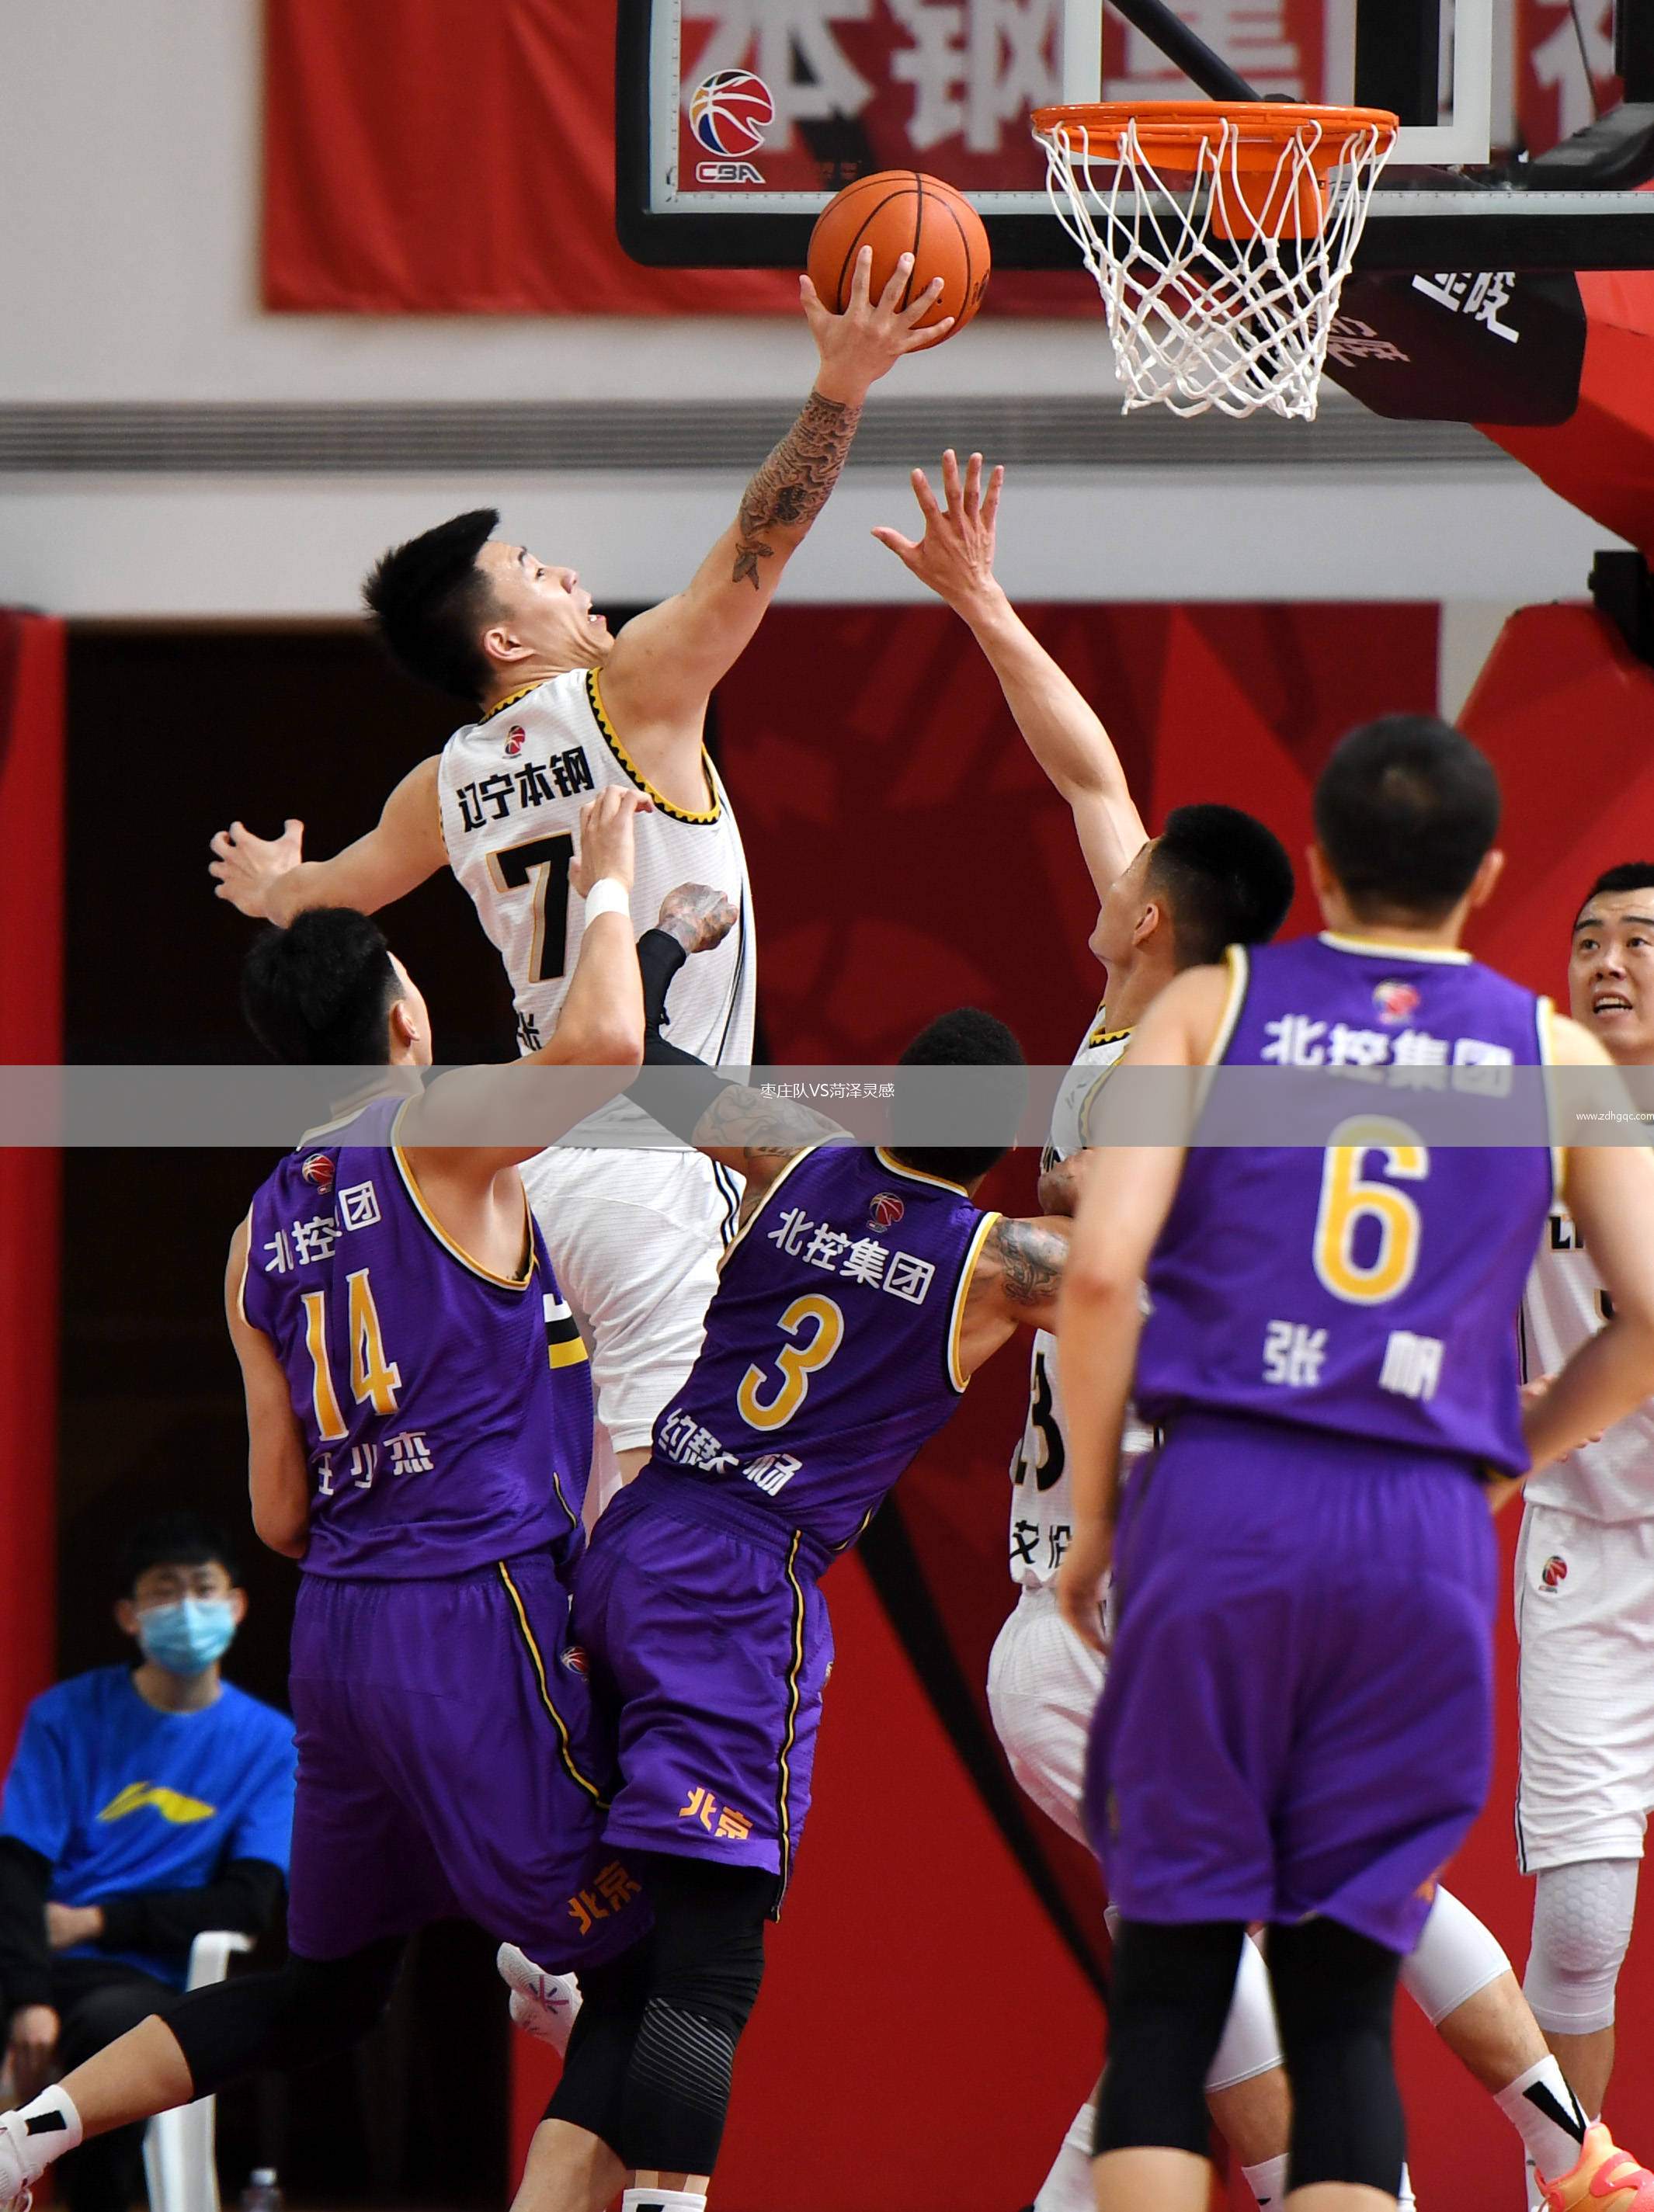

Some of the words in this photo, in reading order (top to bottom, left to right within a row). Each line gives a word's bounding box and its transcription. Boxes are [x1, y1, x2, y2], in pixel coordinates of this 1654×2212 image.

[696, 162, 766, 184] CBA
[456, 746, 595, 833] 辽宁本钢
[486, 832, 575, 984] 7
[1262, 1014, 1514, 1099] 北控集团
[264, 1180, 381, 1273] 北控团
[1313, 1114, 1430, 1305] 6
[767, 1207, 936, 1306] 北控集团
[301, 1268, 401, 1442] 14
[736, 1293, 845, 1432] 3
[679, 1786, 754, 1840] 北京
[567, 1860, 642, 1936] 北京
